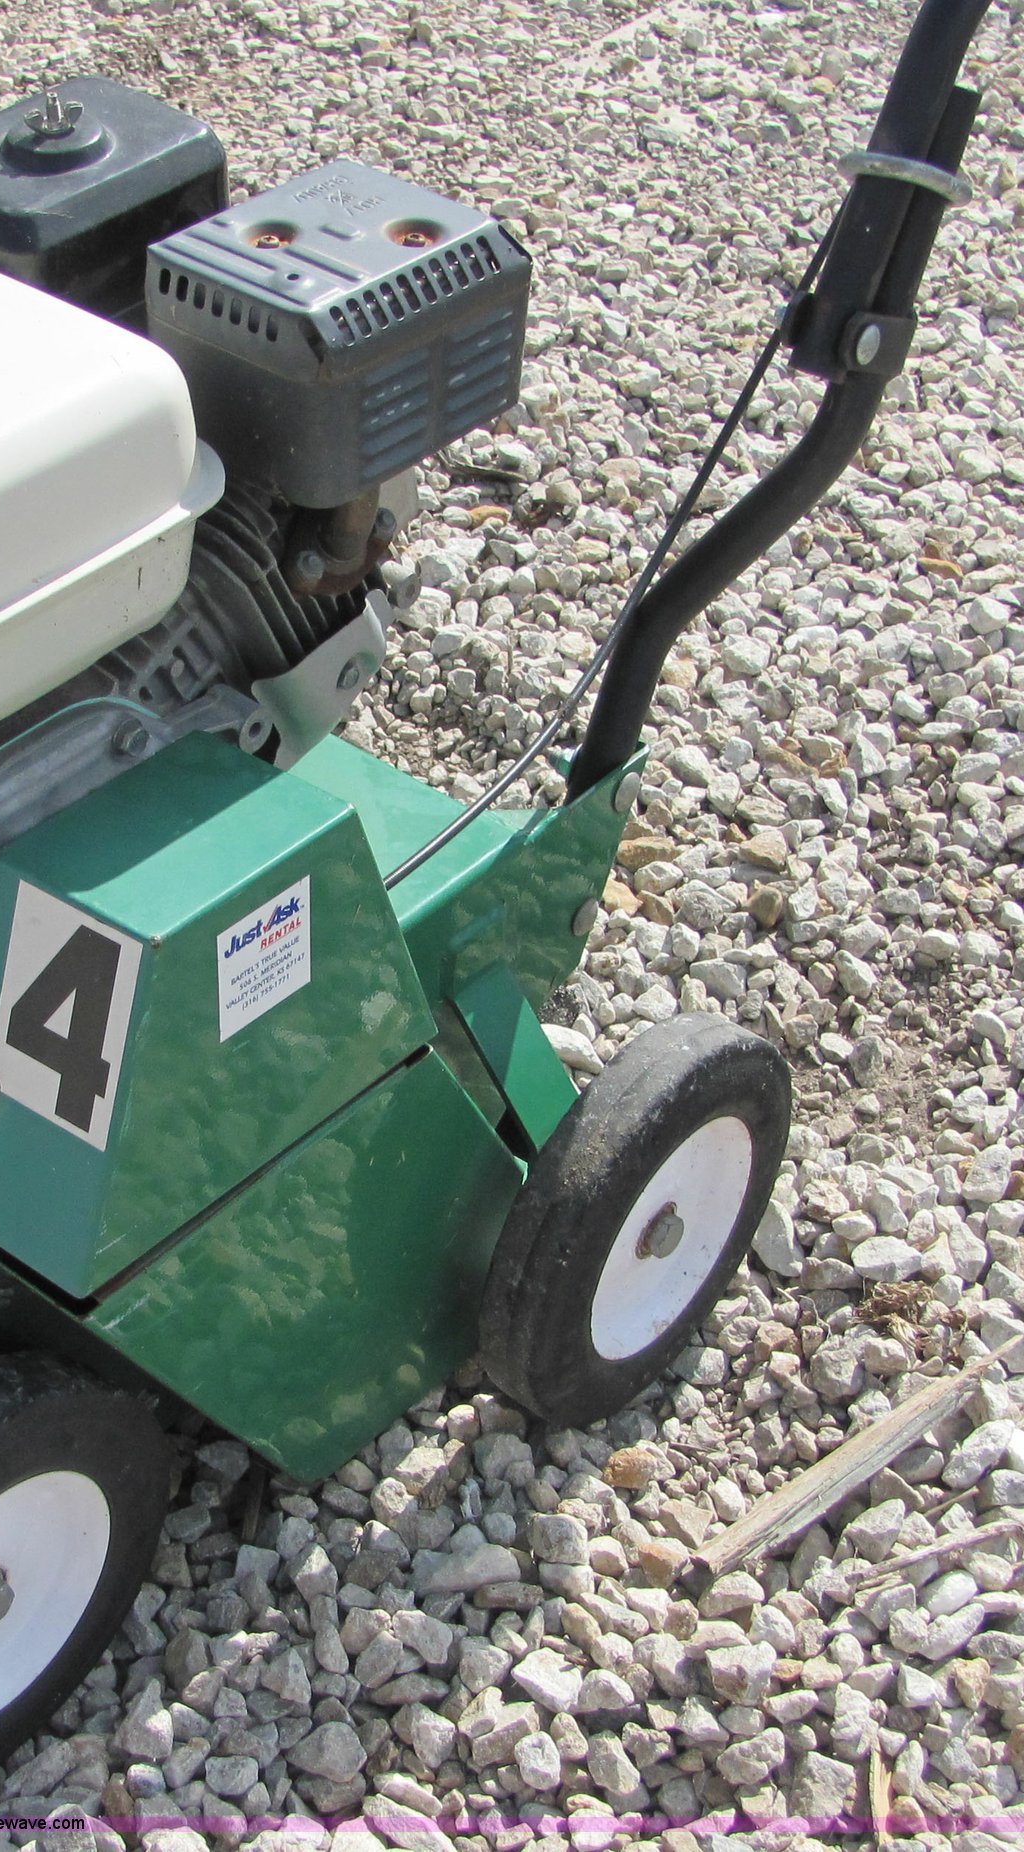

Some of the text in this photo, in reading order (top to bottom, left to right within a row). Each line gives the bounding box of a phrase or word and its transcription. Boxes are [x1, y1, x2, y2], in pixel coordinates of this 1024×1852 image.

[224, 897, 301, 959] Just Ask
[260, 917, 302, 950] RENTAL
[240, 979, 252, 990] 506
[261, 951, 292, 976] MERIDIAN
[261, 950, 278, 967] TRUE
[279, 936, 300, 953] VALUE
[226, 990, 249, 1009] VALLEY
[286, 953, 305, 970] 67147
[242, 974, 290, 1011] (316) 755-1771
[6, 924, 121, 1133] 4
